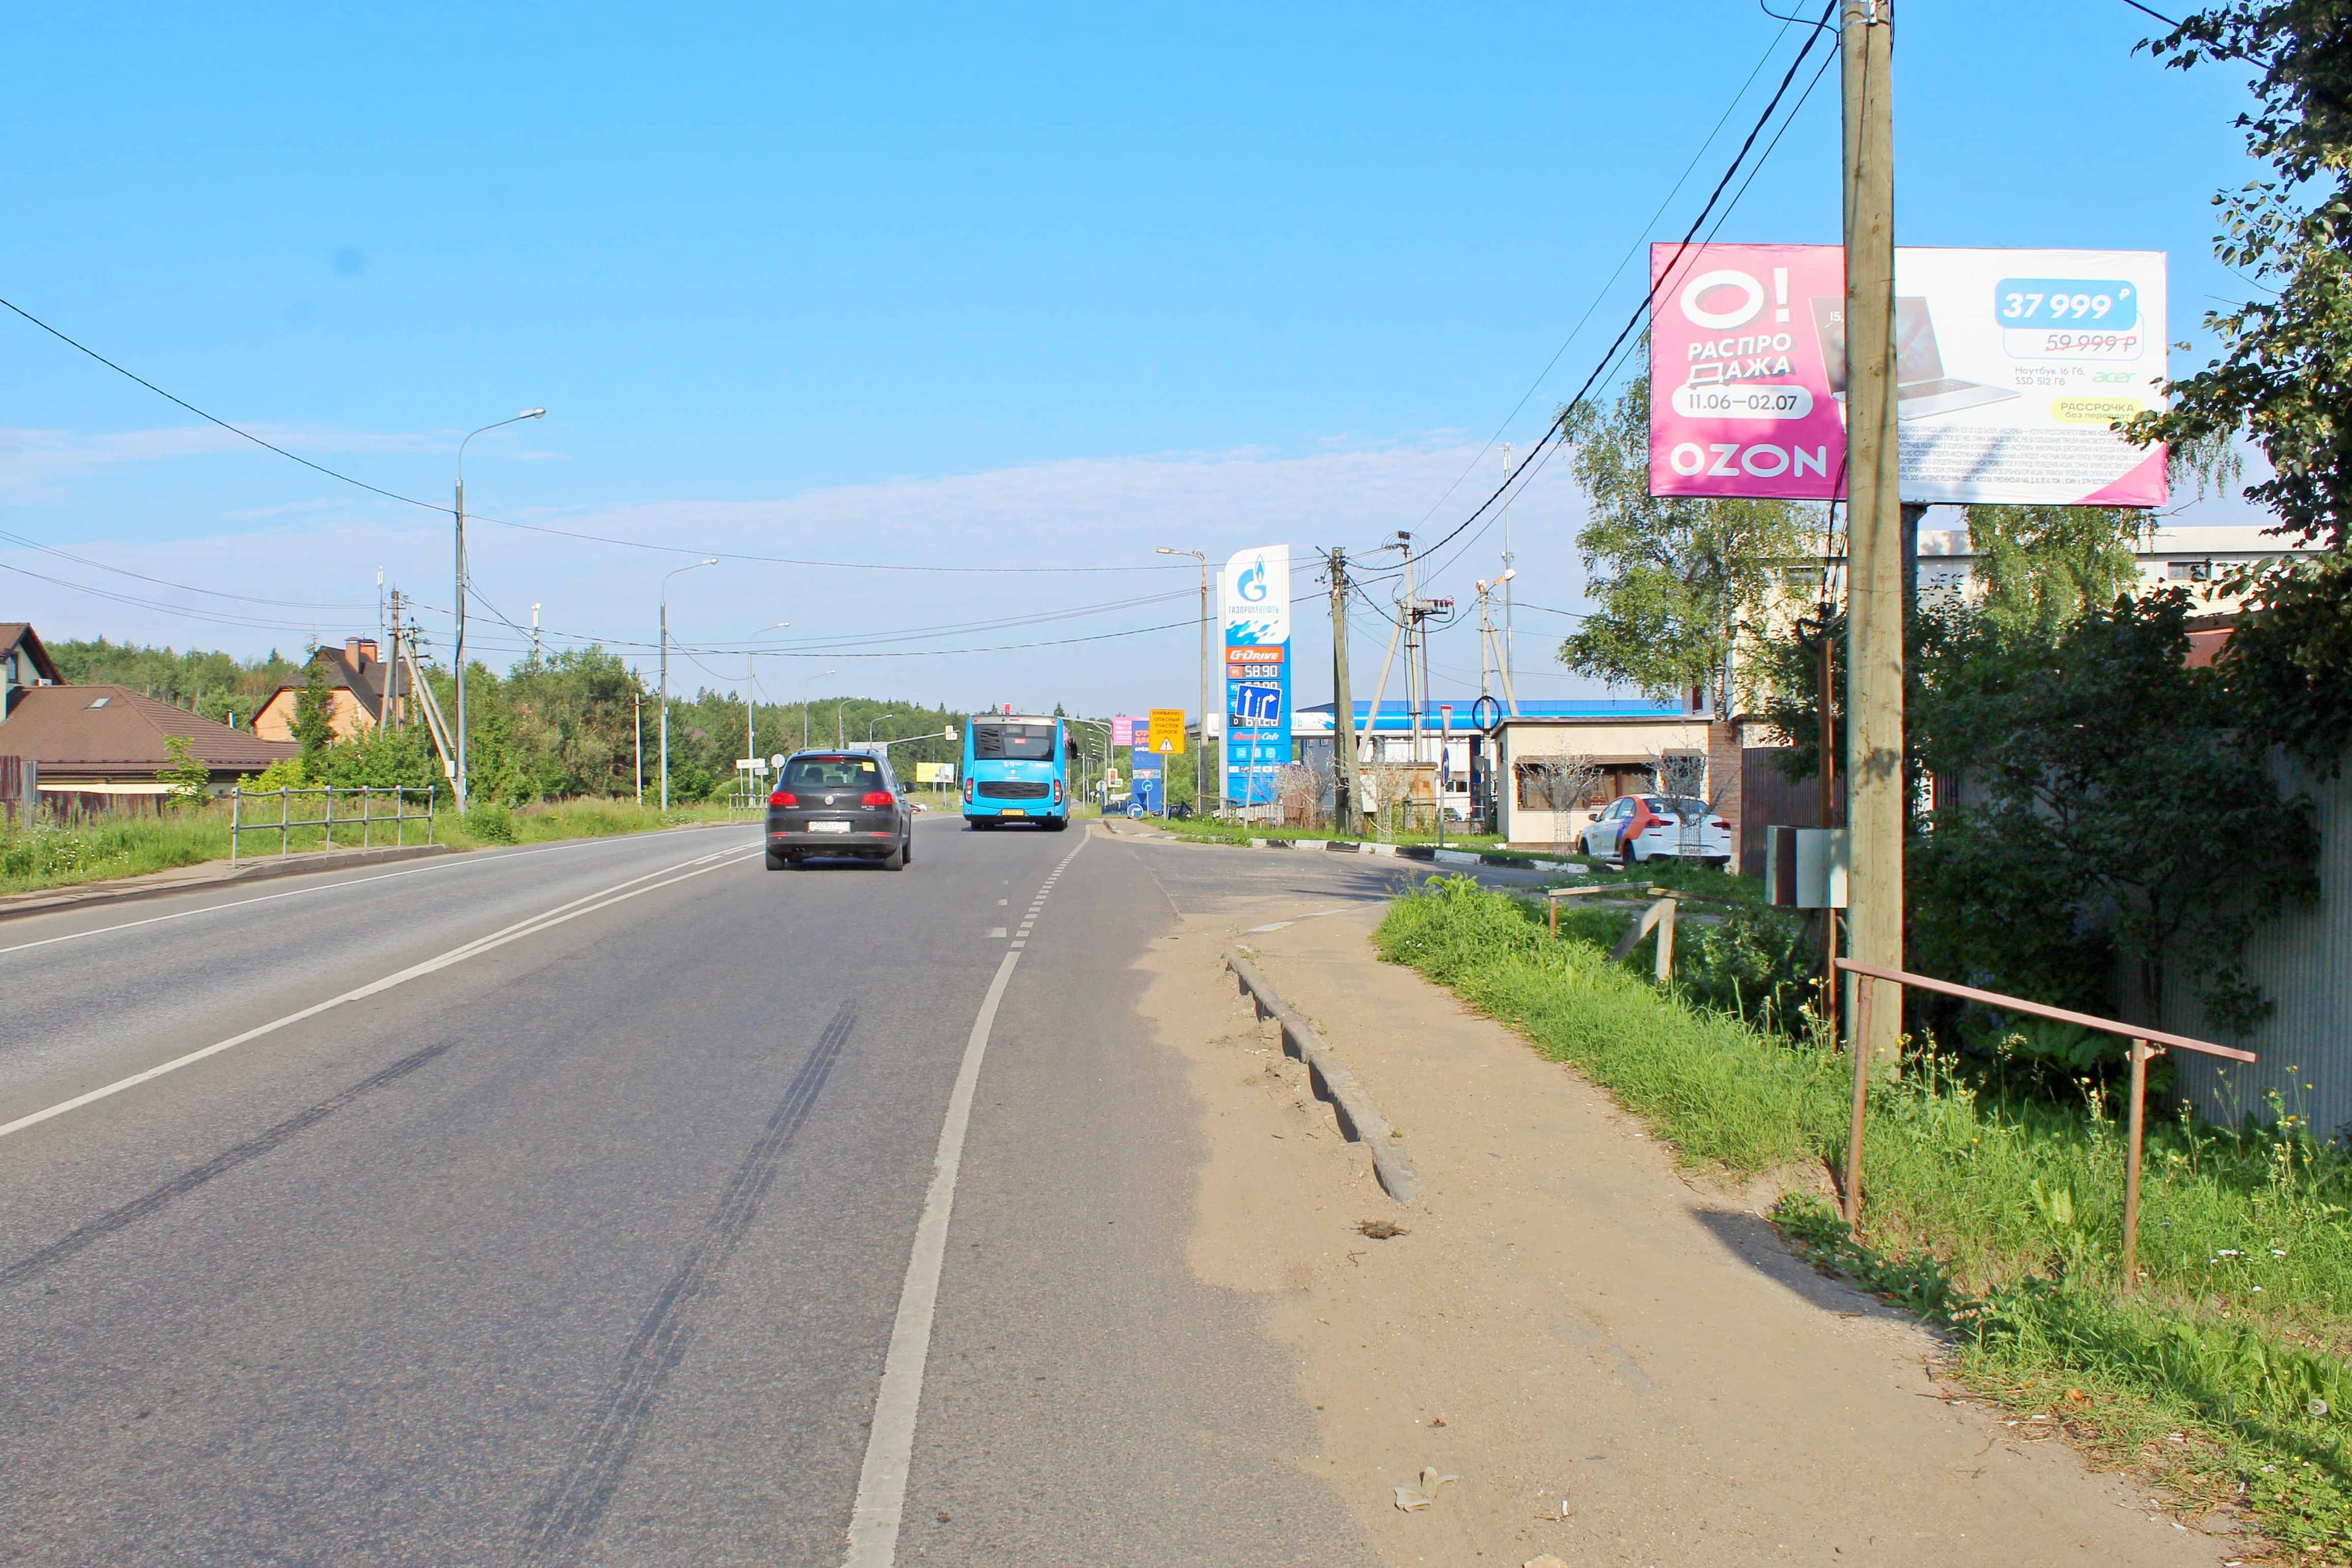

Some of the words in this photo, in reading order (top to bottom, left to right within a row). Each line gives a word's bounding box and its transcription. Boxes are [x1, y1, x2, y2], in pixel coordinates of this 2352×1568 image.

[2002, 293, 2045, 318] 37
[2049, 294, 2112, 320] 999
[1687, 333, 1791, 361] РАСПРО
[2046, 334, 2071, 351] 59
[2077, 335, 2117, 352] 999
[1687, 356, 1791, 386] ДАЖА
[2015, 366, 2056, 379] Ноутбук
[2092, 372, 2136, 383] acer
[2015, 377, 2034, 385] SSD
[2061, 403, 2134, 412] РАССРОЧКА
[1670, 443, 1826, 478] OZON
[1229, 606, 1279, 614] ГАЗПРОМНЕФТЬ
[1245, 665, 1278, 677] 58.90
